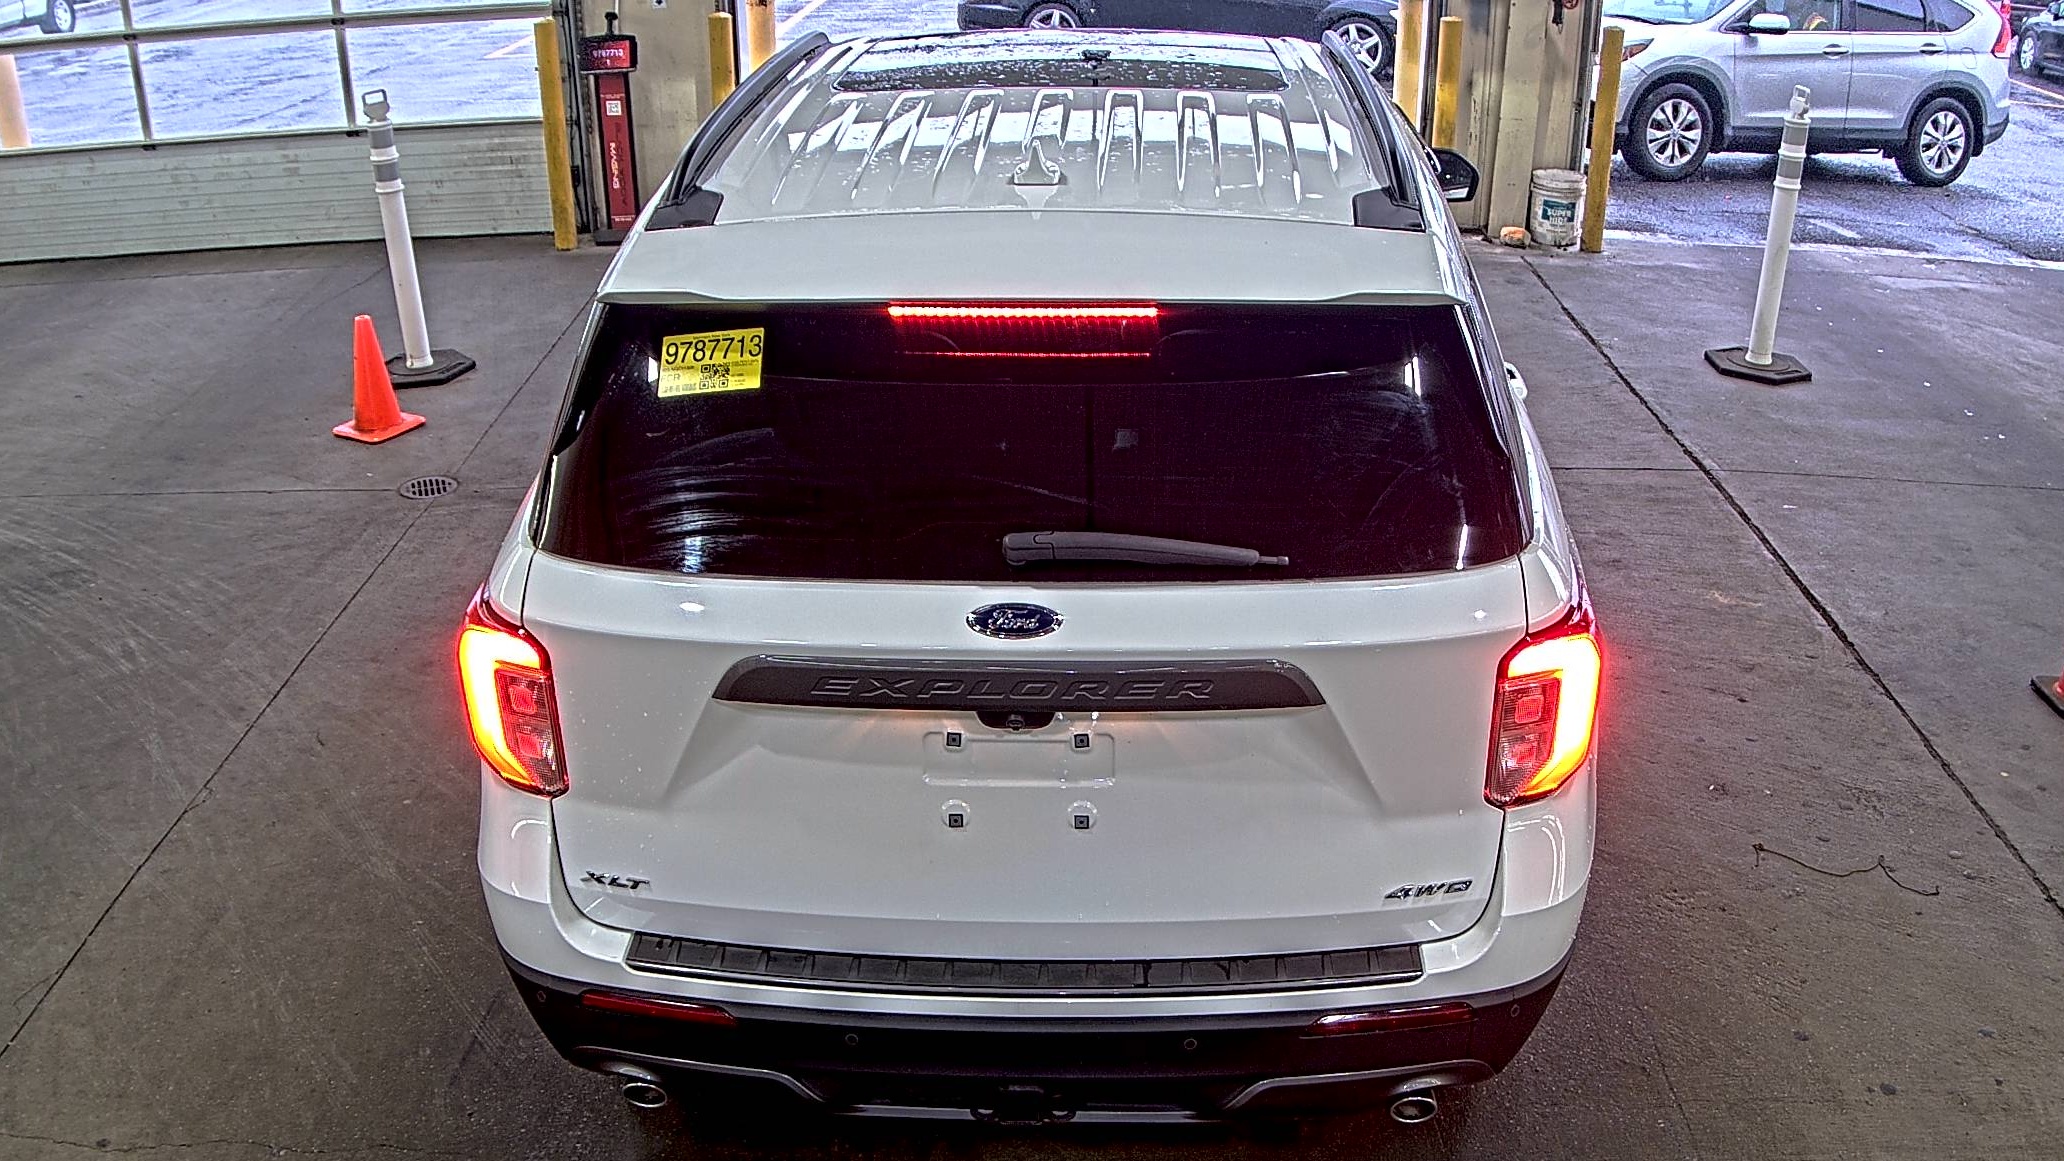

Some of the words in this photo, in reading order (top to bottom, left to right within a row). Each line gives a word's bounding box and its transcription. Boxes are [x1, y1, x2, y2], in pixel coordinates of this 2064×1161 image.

[1546, 208, 1572, 218] SUPER
[665, 334, 762, 365] 9787713
[811, 674, 1216, 700] EXPLORER
[580, 870, 650, 890] XLT
[1384, 879, 1473, 900] 4WD
